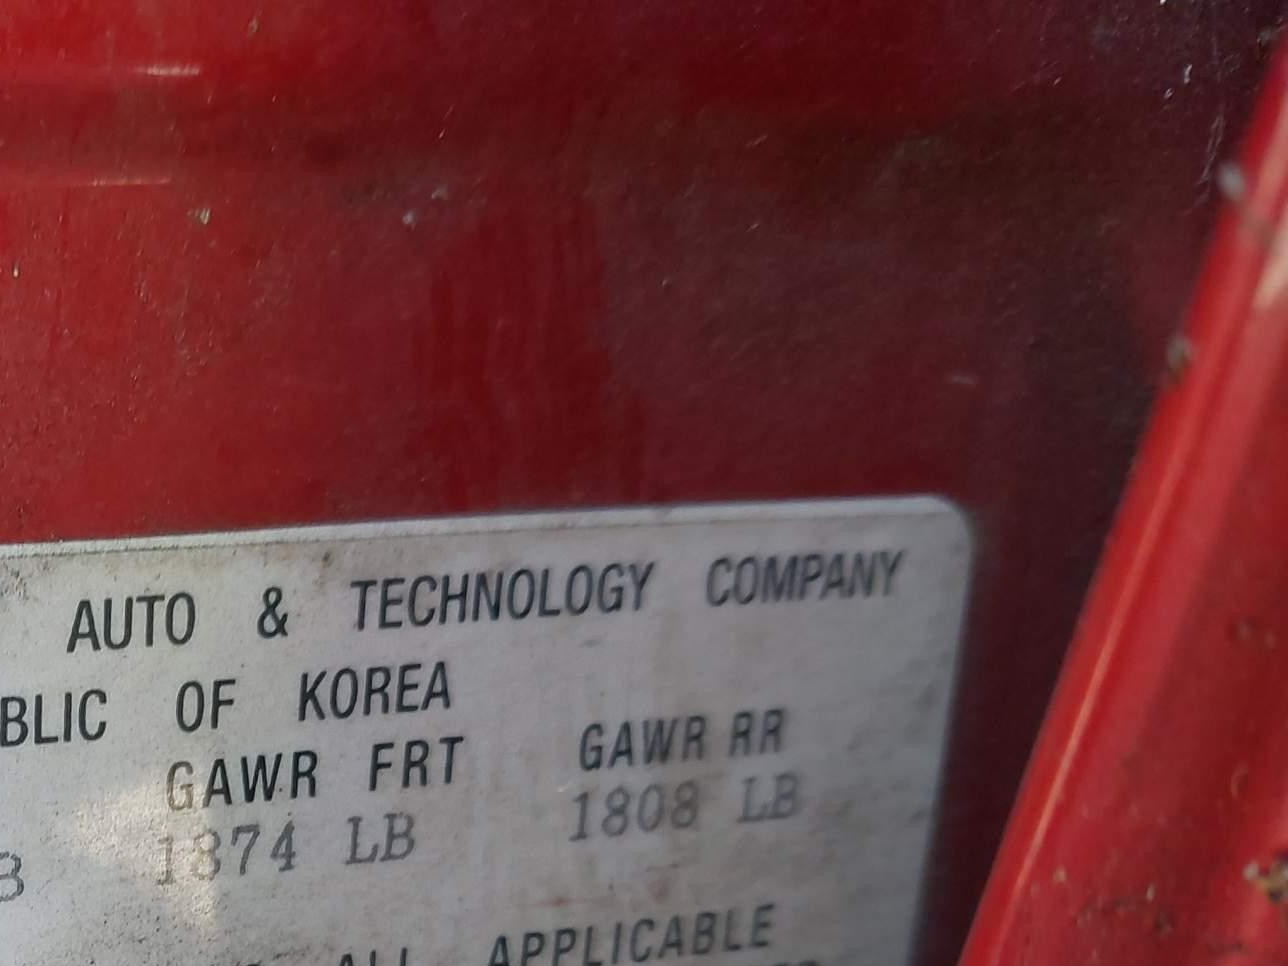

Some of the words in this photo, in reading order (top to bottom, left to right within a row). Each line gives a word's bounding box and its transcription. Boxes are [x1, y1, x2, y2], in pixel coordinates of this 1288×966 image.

[67, 592, 196, 653] AUTO
[257, 586, 289, 639] &
[351, 561, 656, 631] TECHNOLOGY
[706, 549, 906, 607] COMPANY
[175, 679, 237, 733] OF
[299, 661, 451, 722] KOREA
[167, 749, 318, 811] GAWR
[369, 736, 464, 792] FRT
[580, 714, 707, 772] GAWR
[728, 708, 787, 757] RR
[570, 781, 702, 841] 1808
[736, 773, 803, 824] LB
[157, 820, 296, 886] 1874
[345, 812, 416, 865] LB
